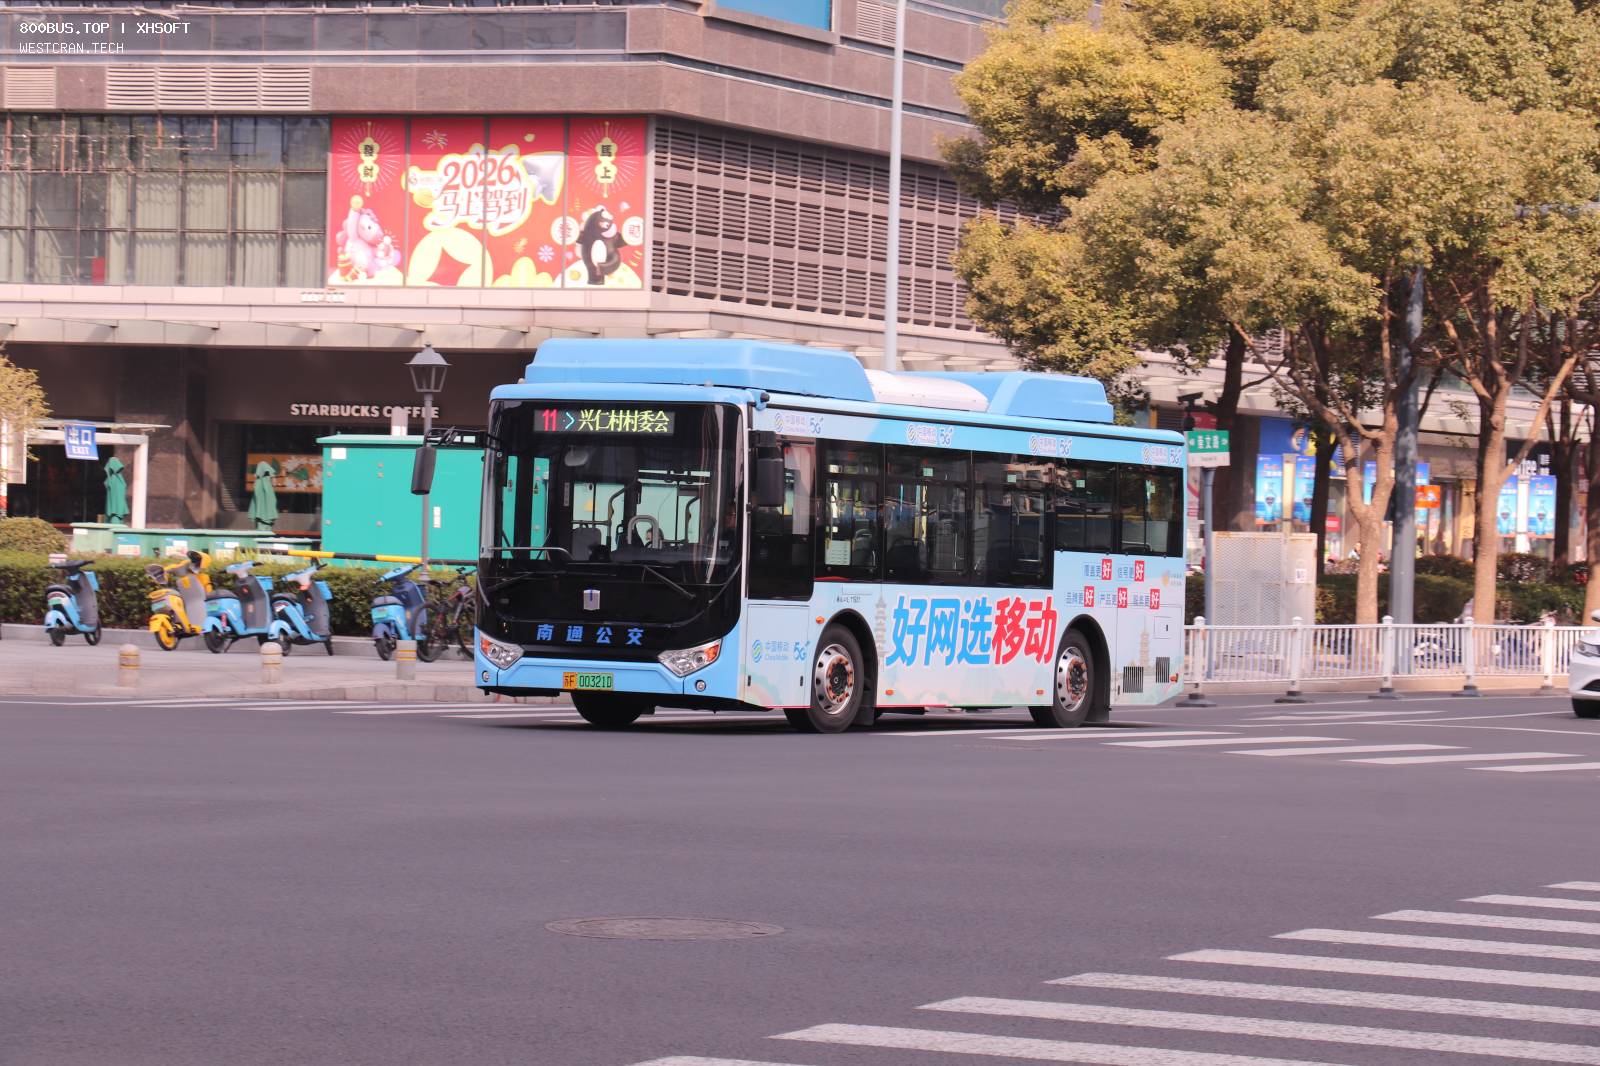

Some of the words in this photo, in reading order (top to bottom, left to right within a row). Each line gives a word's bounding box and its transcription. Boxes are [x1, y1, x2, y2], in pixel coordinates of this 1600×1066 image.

[443, 154, 521, 189] 2026
[439, 187, 527, 224] 马上驾到
[290, 403, 380, 418] STARBUCKS
[543, 409, 557, 432] 11
[578, 409, 670, 432] 兴仁村村委会
[68, 427, 92, 445] 出口
[809, 417, 823, 434] 5G
[939, 429, 953, 445] 5G
[71, 445, 90, 455] EXIT
[536, 623, 645, 646] 南通公交
[886, 595, 1058, 667] 好网选移动
[793, 640, 809, 661] 5G
